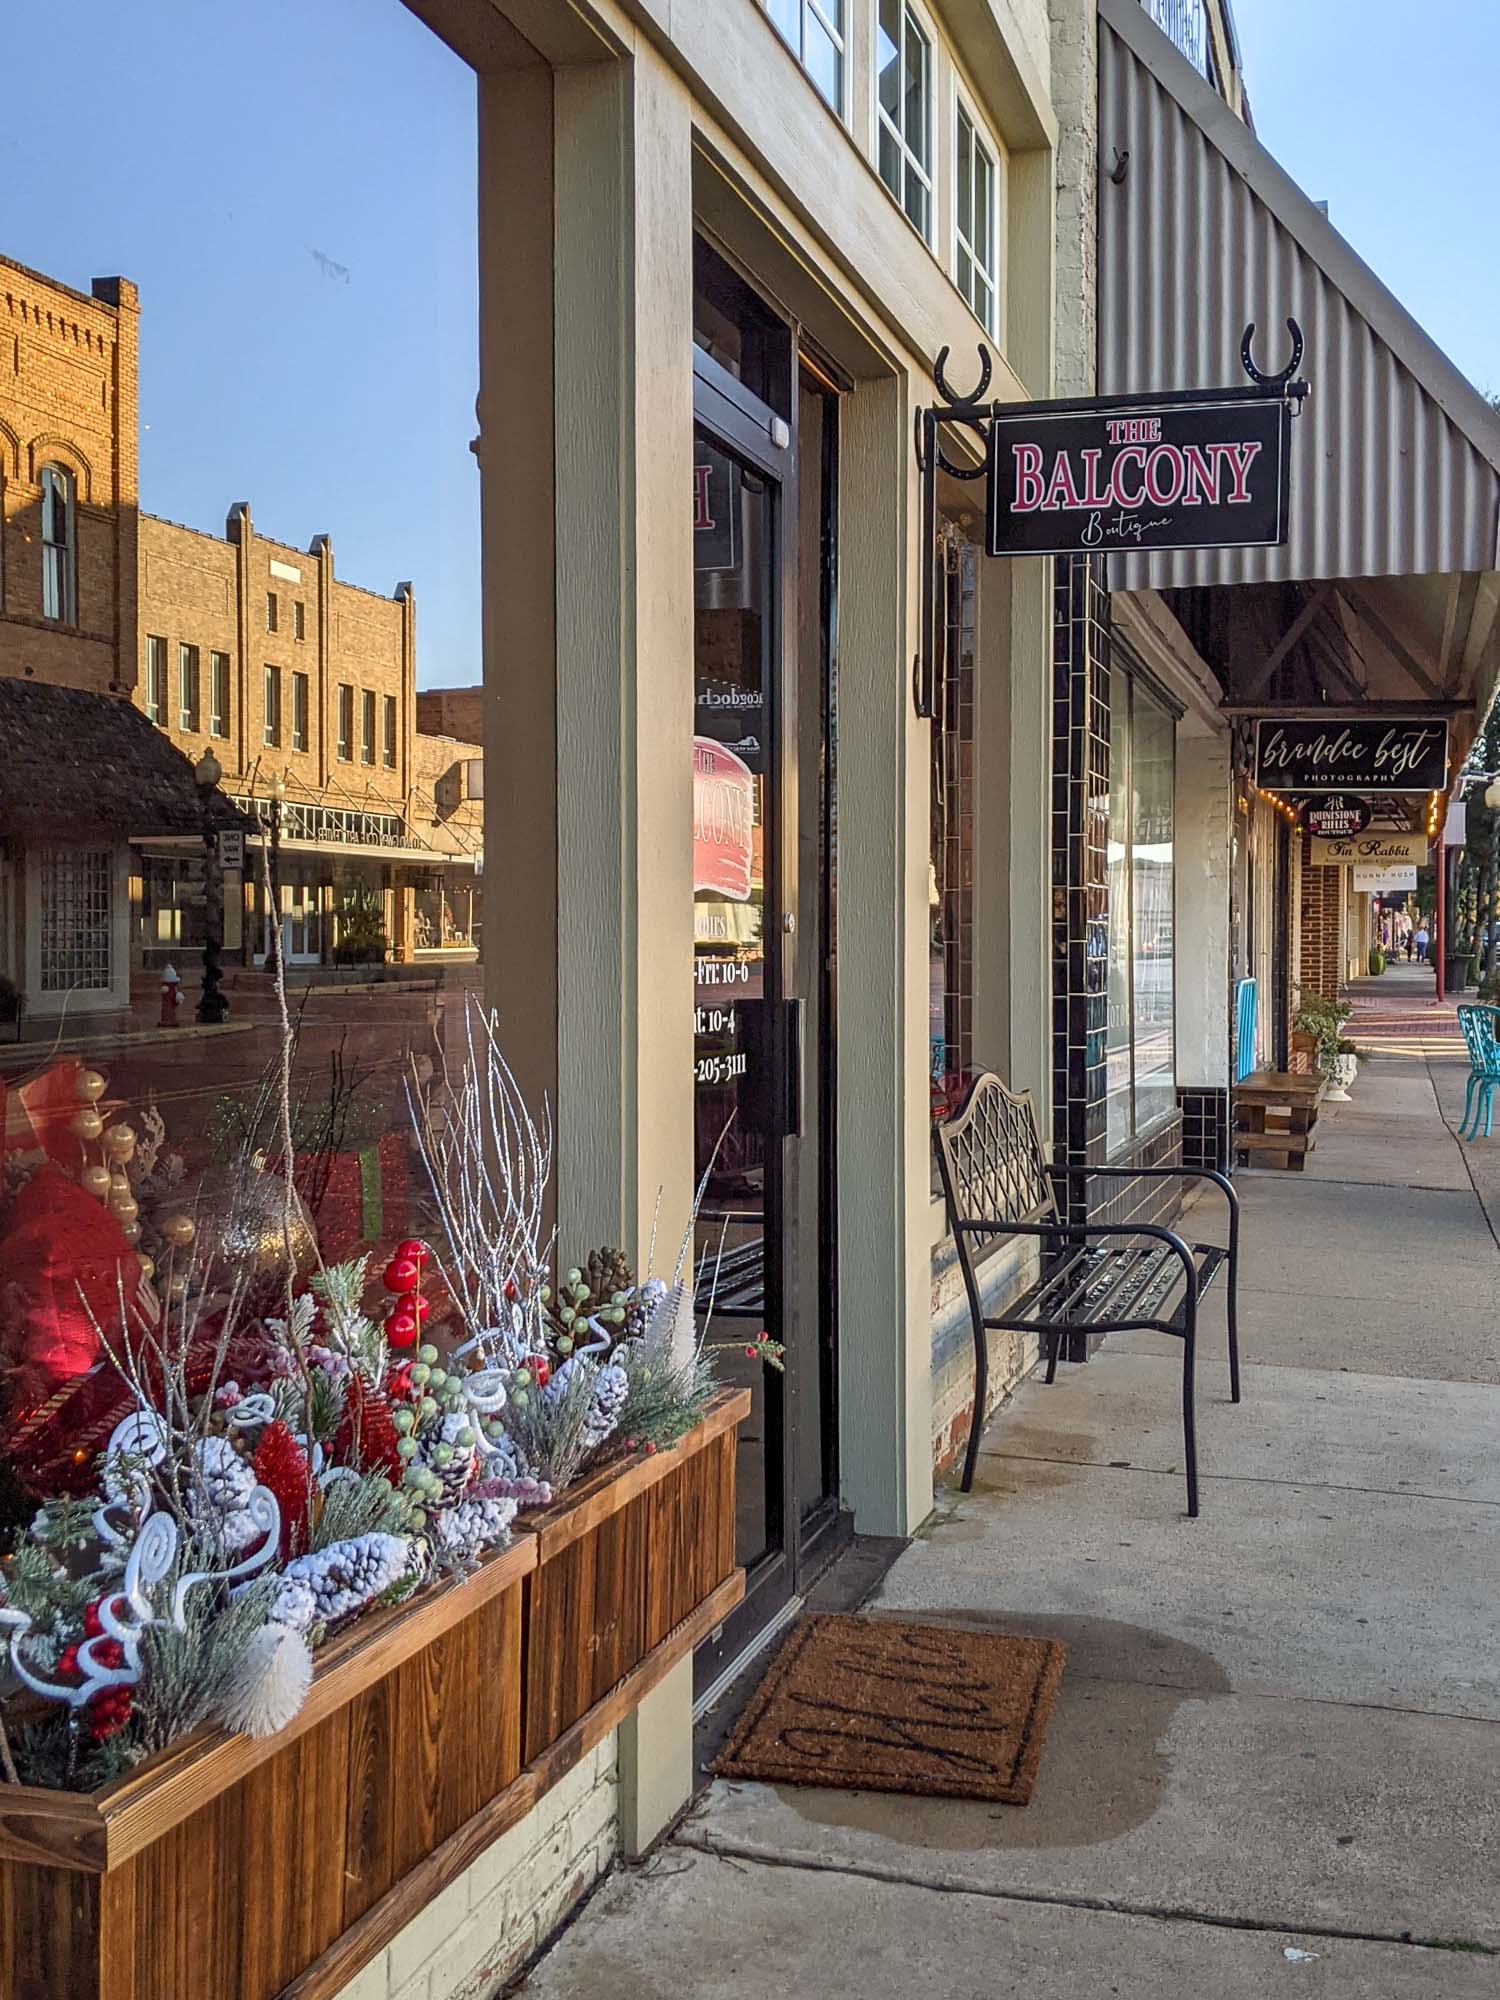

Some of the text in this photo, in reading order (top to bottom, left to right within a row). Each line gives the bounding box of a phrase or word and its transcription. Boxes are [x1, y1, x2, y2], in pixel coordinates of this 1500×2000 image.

[1106, 418, 1162, 445] THE
[1010, 442, 1262, 512] BALCONY
[1081, 511, 1173, 546] Boutique
[1262, 728, 1442, 775] brandee best
[1303, 774, 1397, 783] PHOTOGRAPHY
[1327, 839, 1410, 857] Tin Rabbit
[722, 959, 749, 984] 10-6
[708, 1008, 736, 1035] 10-4
